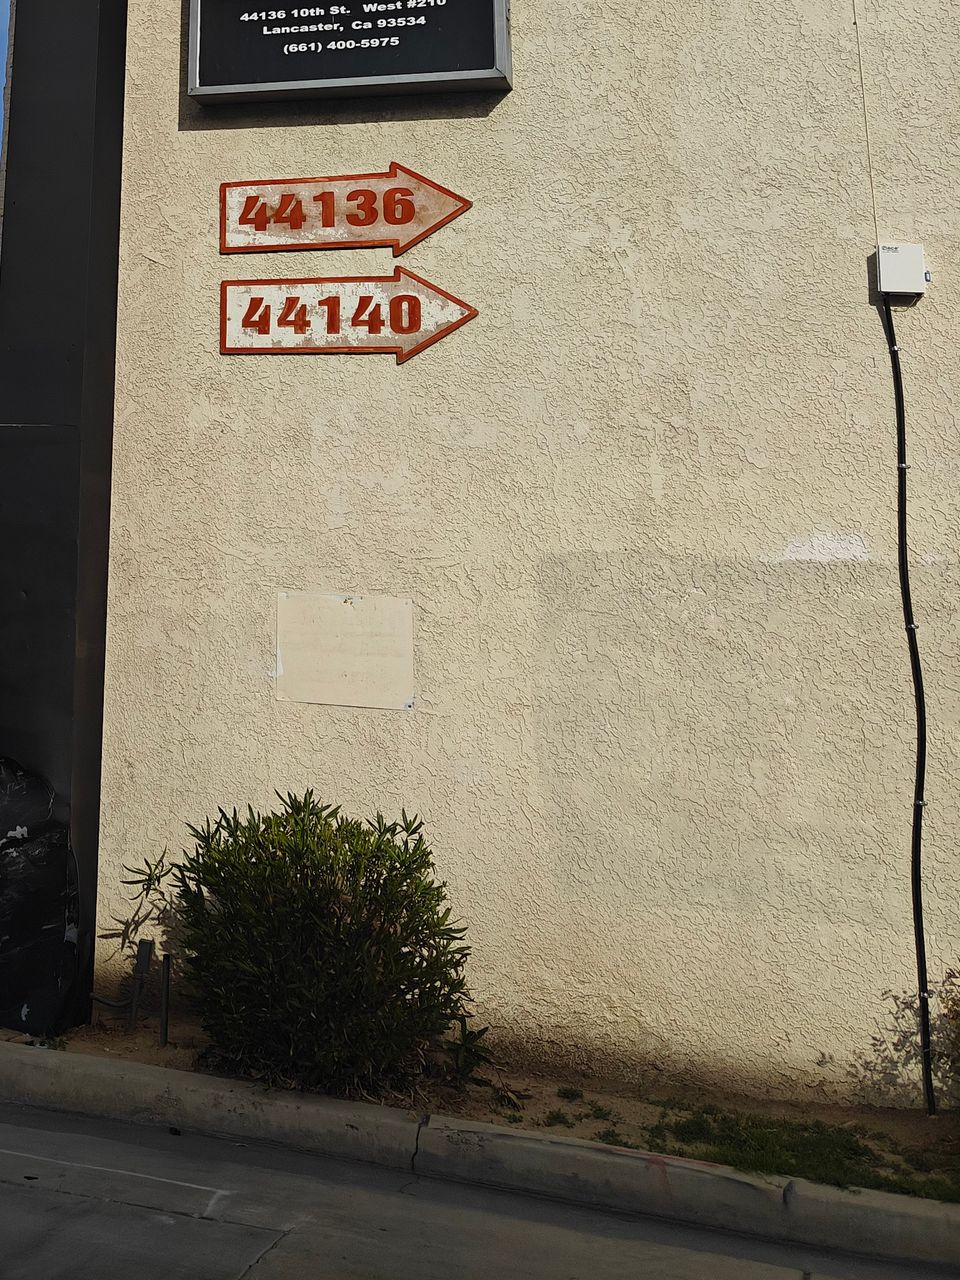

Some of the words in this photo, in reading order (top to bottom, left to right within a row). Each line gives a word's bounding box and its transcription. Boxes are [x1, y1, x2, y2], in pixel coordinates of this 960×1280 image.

[240, 10, 286, 21] 44136
[291, 6, 325, 18] 10th
[329, 5, 351, 15] St.
[362, 1, 402, 13] West
[262, 22, 344, 35] Lancaster,
[351, 20, 373, 30] Ca
[376, 16, 427, 29] 93534
[283, 41, 323, 55] (661)
[326, 36, 400, 50] 400-5975
[238, 187, 416, 231] 44136
[241, 294, 422, 336] 44140
